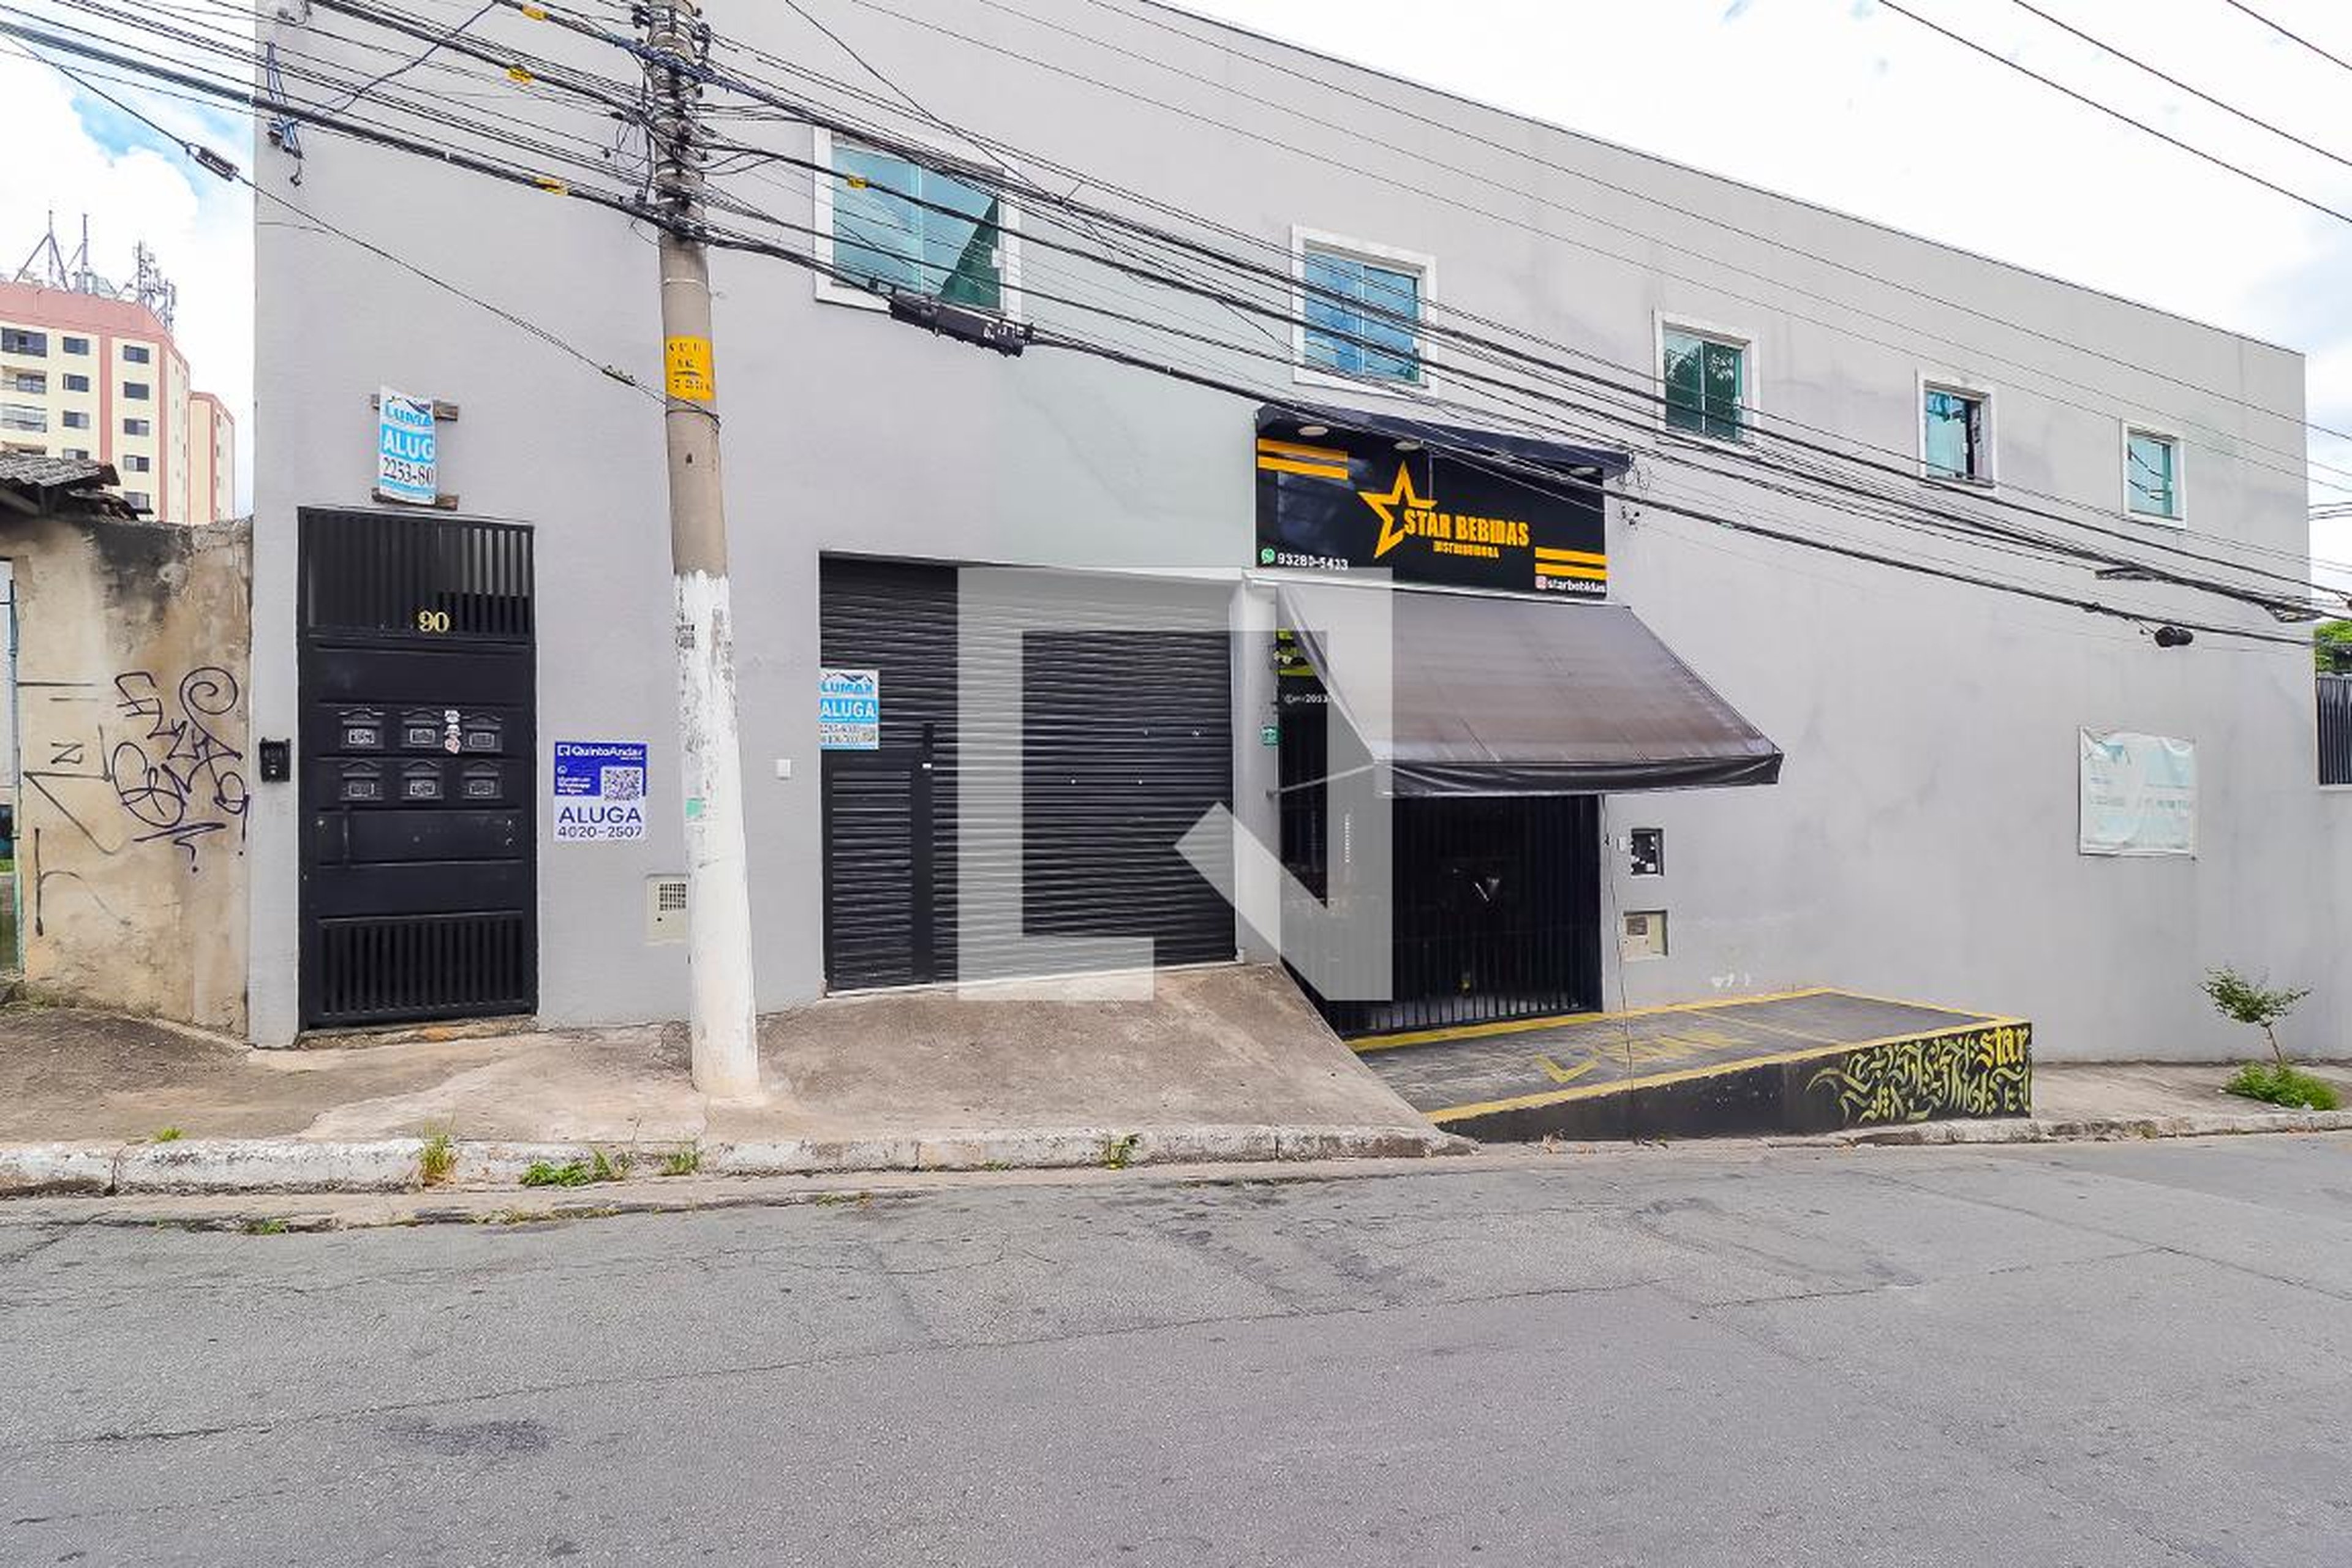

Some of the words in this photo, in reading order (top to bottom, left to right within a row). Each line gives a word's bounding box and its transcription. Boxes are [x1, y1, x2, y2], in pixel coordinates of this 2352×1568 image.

[1404, 508, 1450, 540] STAR
[1455, 514, 1529, 547] BEBIDAS
[418, 611, 450, 633] 90
[821, 702, 875, 717] ALUGA
[571, 745, 644, 757] QuintoAndar
[559, 807, 642, 823] ALUGA
[558, 826, 642, 838] 4020-2507
